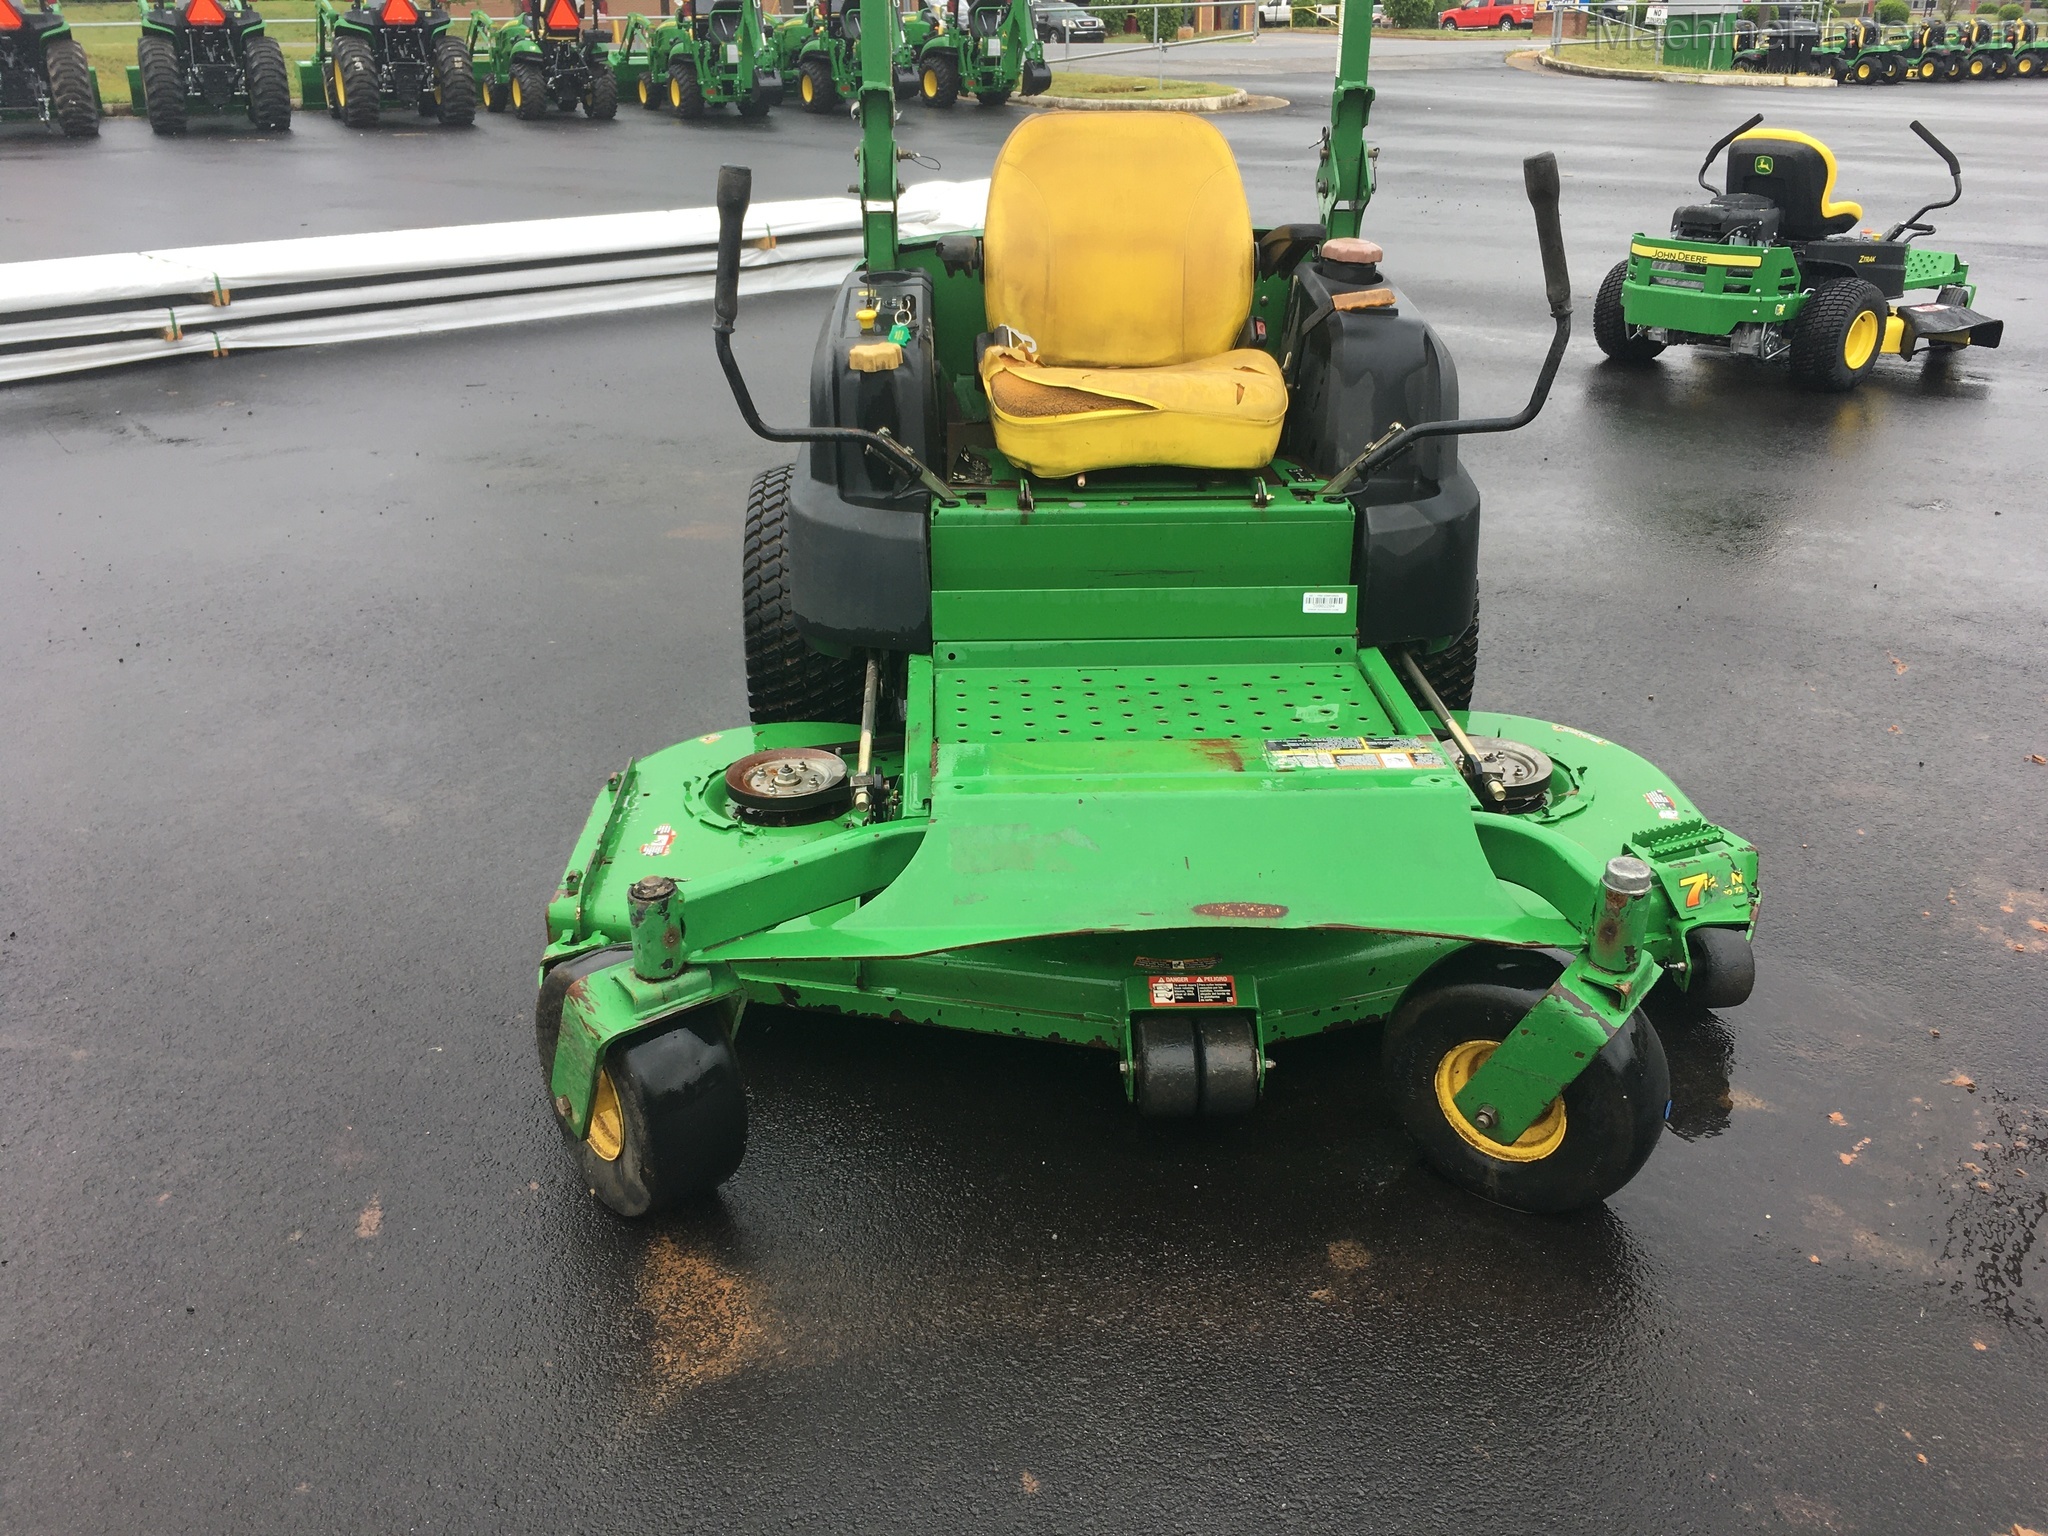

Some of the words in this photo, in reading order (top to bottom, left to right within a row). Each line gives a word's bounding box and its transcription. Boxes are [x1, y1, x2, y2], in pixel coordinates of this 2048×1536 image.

[1652, 249, 1676, 260] JOHN
[1677, 252, 1708, 263] DEERE
[1680, 872, 1708, 907] 7
